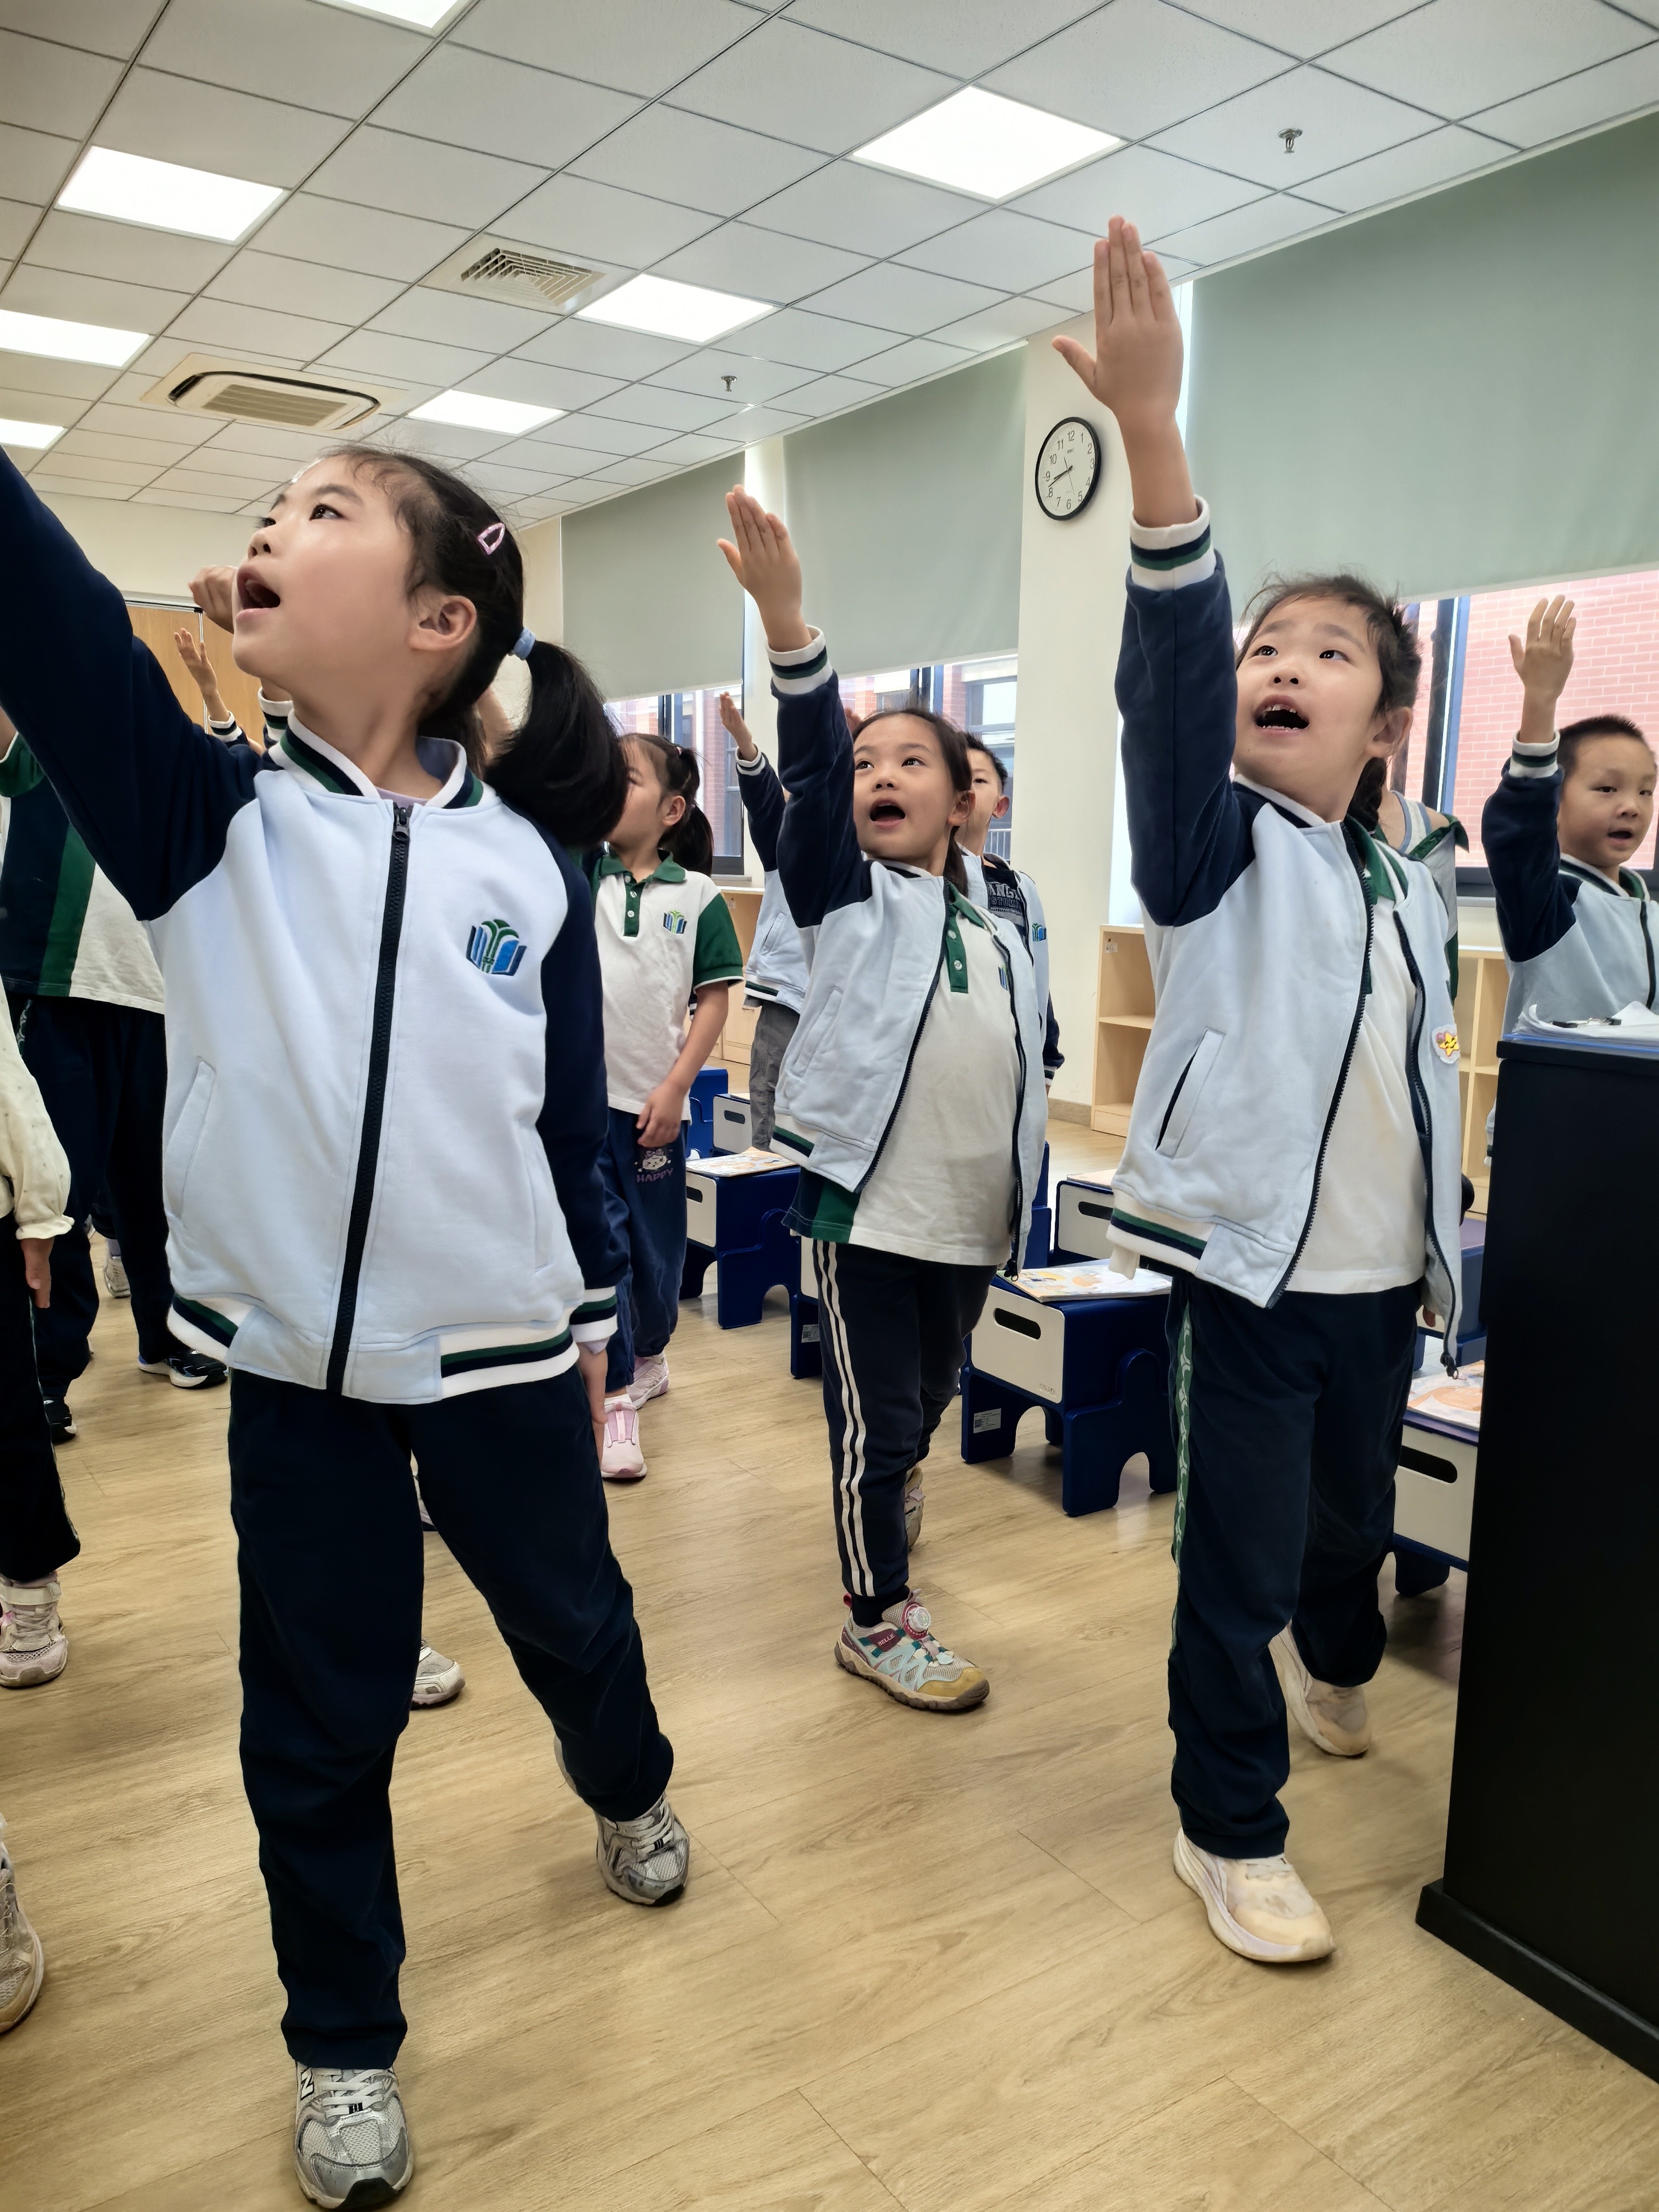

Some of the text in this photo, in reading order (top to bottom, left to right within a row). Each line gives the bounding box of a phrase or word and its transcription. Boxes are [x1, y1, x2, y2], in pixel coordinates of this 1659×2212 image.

[1067, 430, 1075, 442] 12
[1081, 432, 1084, 443] 1
[1057, 439, 1063, 450] 11
[1087, 443, 1092, 455] 2
[1049, 454, 1057, 466] 10
[1090, 458, 1095, 469] 3
[1046, 471, 1050, 482] 9
[1085, 476, 1090, 487] 4
[1048, 487, 1053, 497] 8
[1078, 491, 1083, 502] 5
[1057, 496, 1061, 507] 7
[1066, 498, 1071, 510] 6
[637, 1168, 673, 1182] HAPPY
